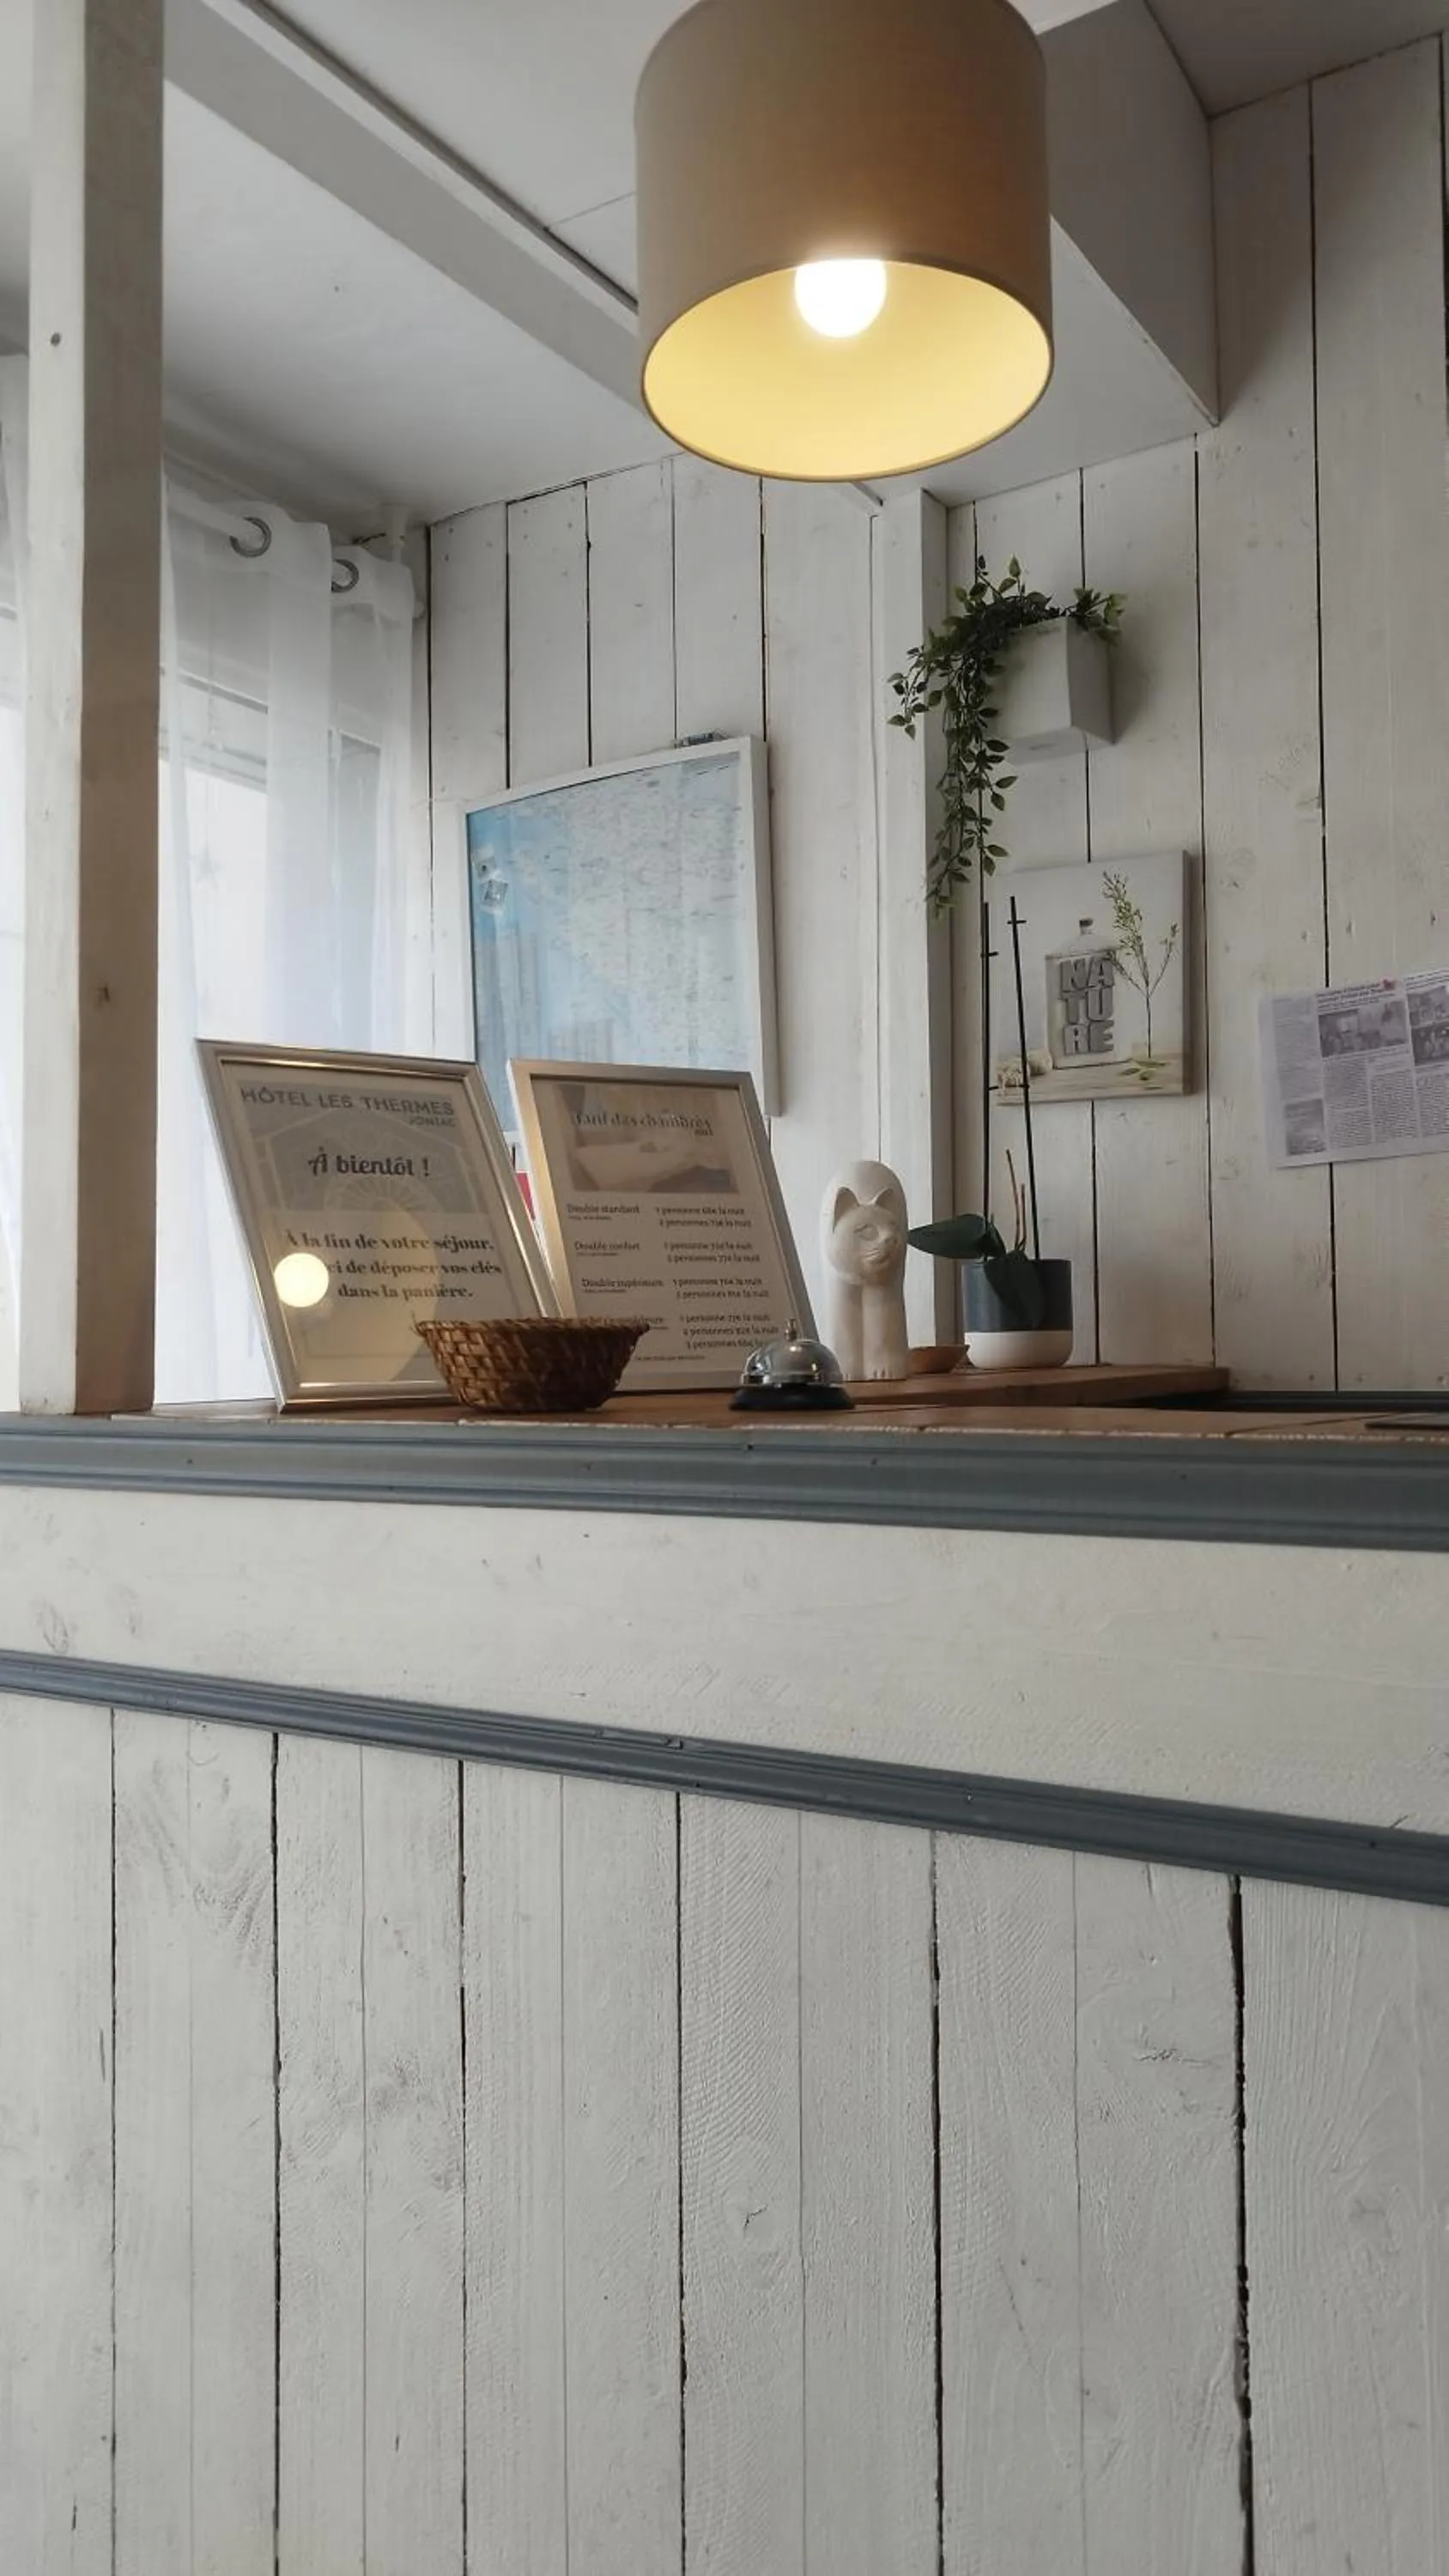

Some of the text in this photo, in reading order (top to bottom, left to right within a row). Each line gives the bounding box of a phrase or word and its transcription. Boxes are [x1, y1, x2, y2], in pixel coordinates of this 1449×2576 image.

[1059, 987, 1113, 1024] TU
[1064, 1019, 1114, 1055] RE
[240, 1086, 454, 1115] HÔTEL LES THERMES
[307, 1145, 329, 1176] À
[336, 1153, 415, 1177] bientôt
[355, 1234, 377, 1249] de
[380, 1236, 430, 1249] votre
[346, 1259, 367, 1274] de
[470, 1260, 503, 1275] clés
[338, 1283, 379, 1297] dans
[380, 1284, 399, 1298] la
